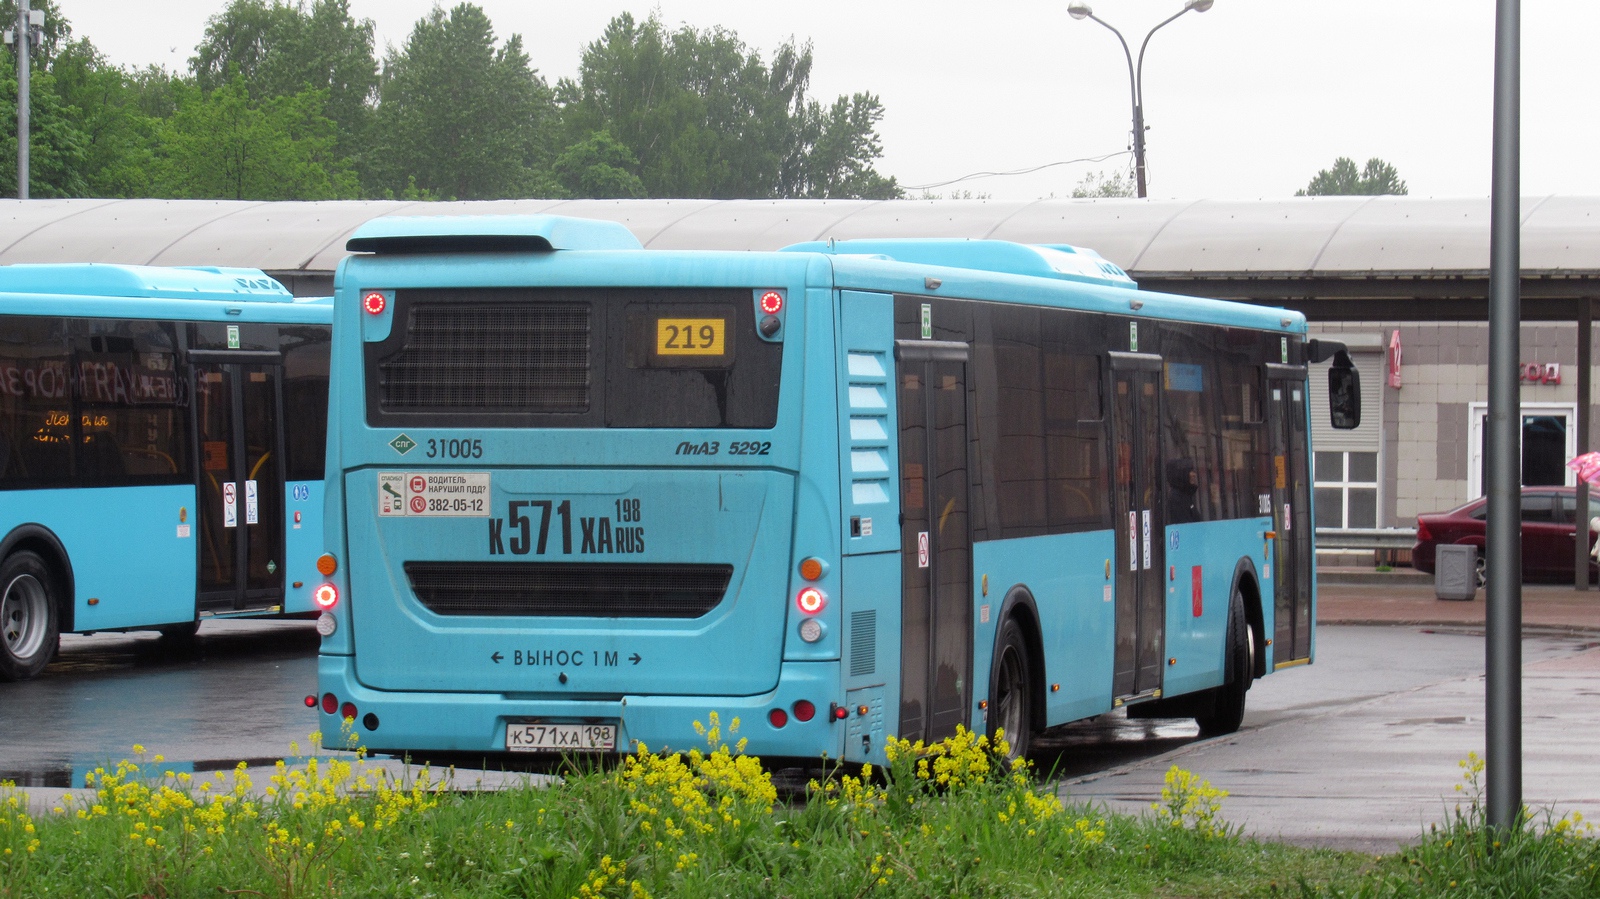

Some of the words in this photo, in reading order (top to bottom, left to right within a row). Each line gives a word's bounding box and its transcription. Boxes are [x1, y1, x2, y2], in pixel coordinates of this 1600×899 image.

[664, 324, 715, 349] 219
[395, 440, 411, 448] СПГ
[426, 438, 483, 459] 31005
[728, 441, 772, 456] 5292
[428, 476, 467, 484] ВОДИТЕЛЬ
[428, 485, 465, 493] НАРУШИЛ
[466, 486, 487, 494] ПДД?
[428, 498, 484, 512] 382-05-12
[615, 498, 641, 523] 198
[615, 526, 645, 554] RUS
[514, 650, 584, 666] ВЫНОС
